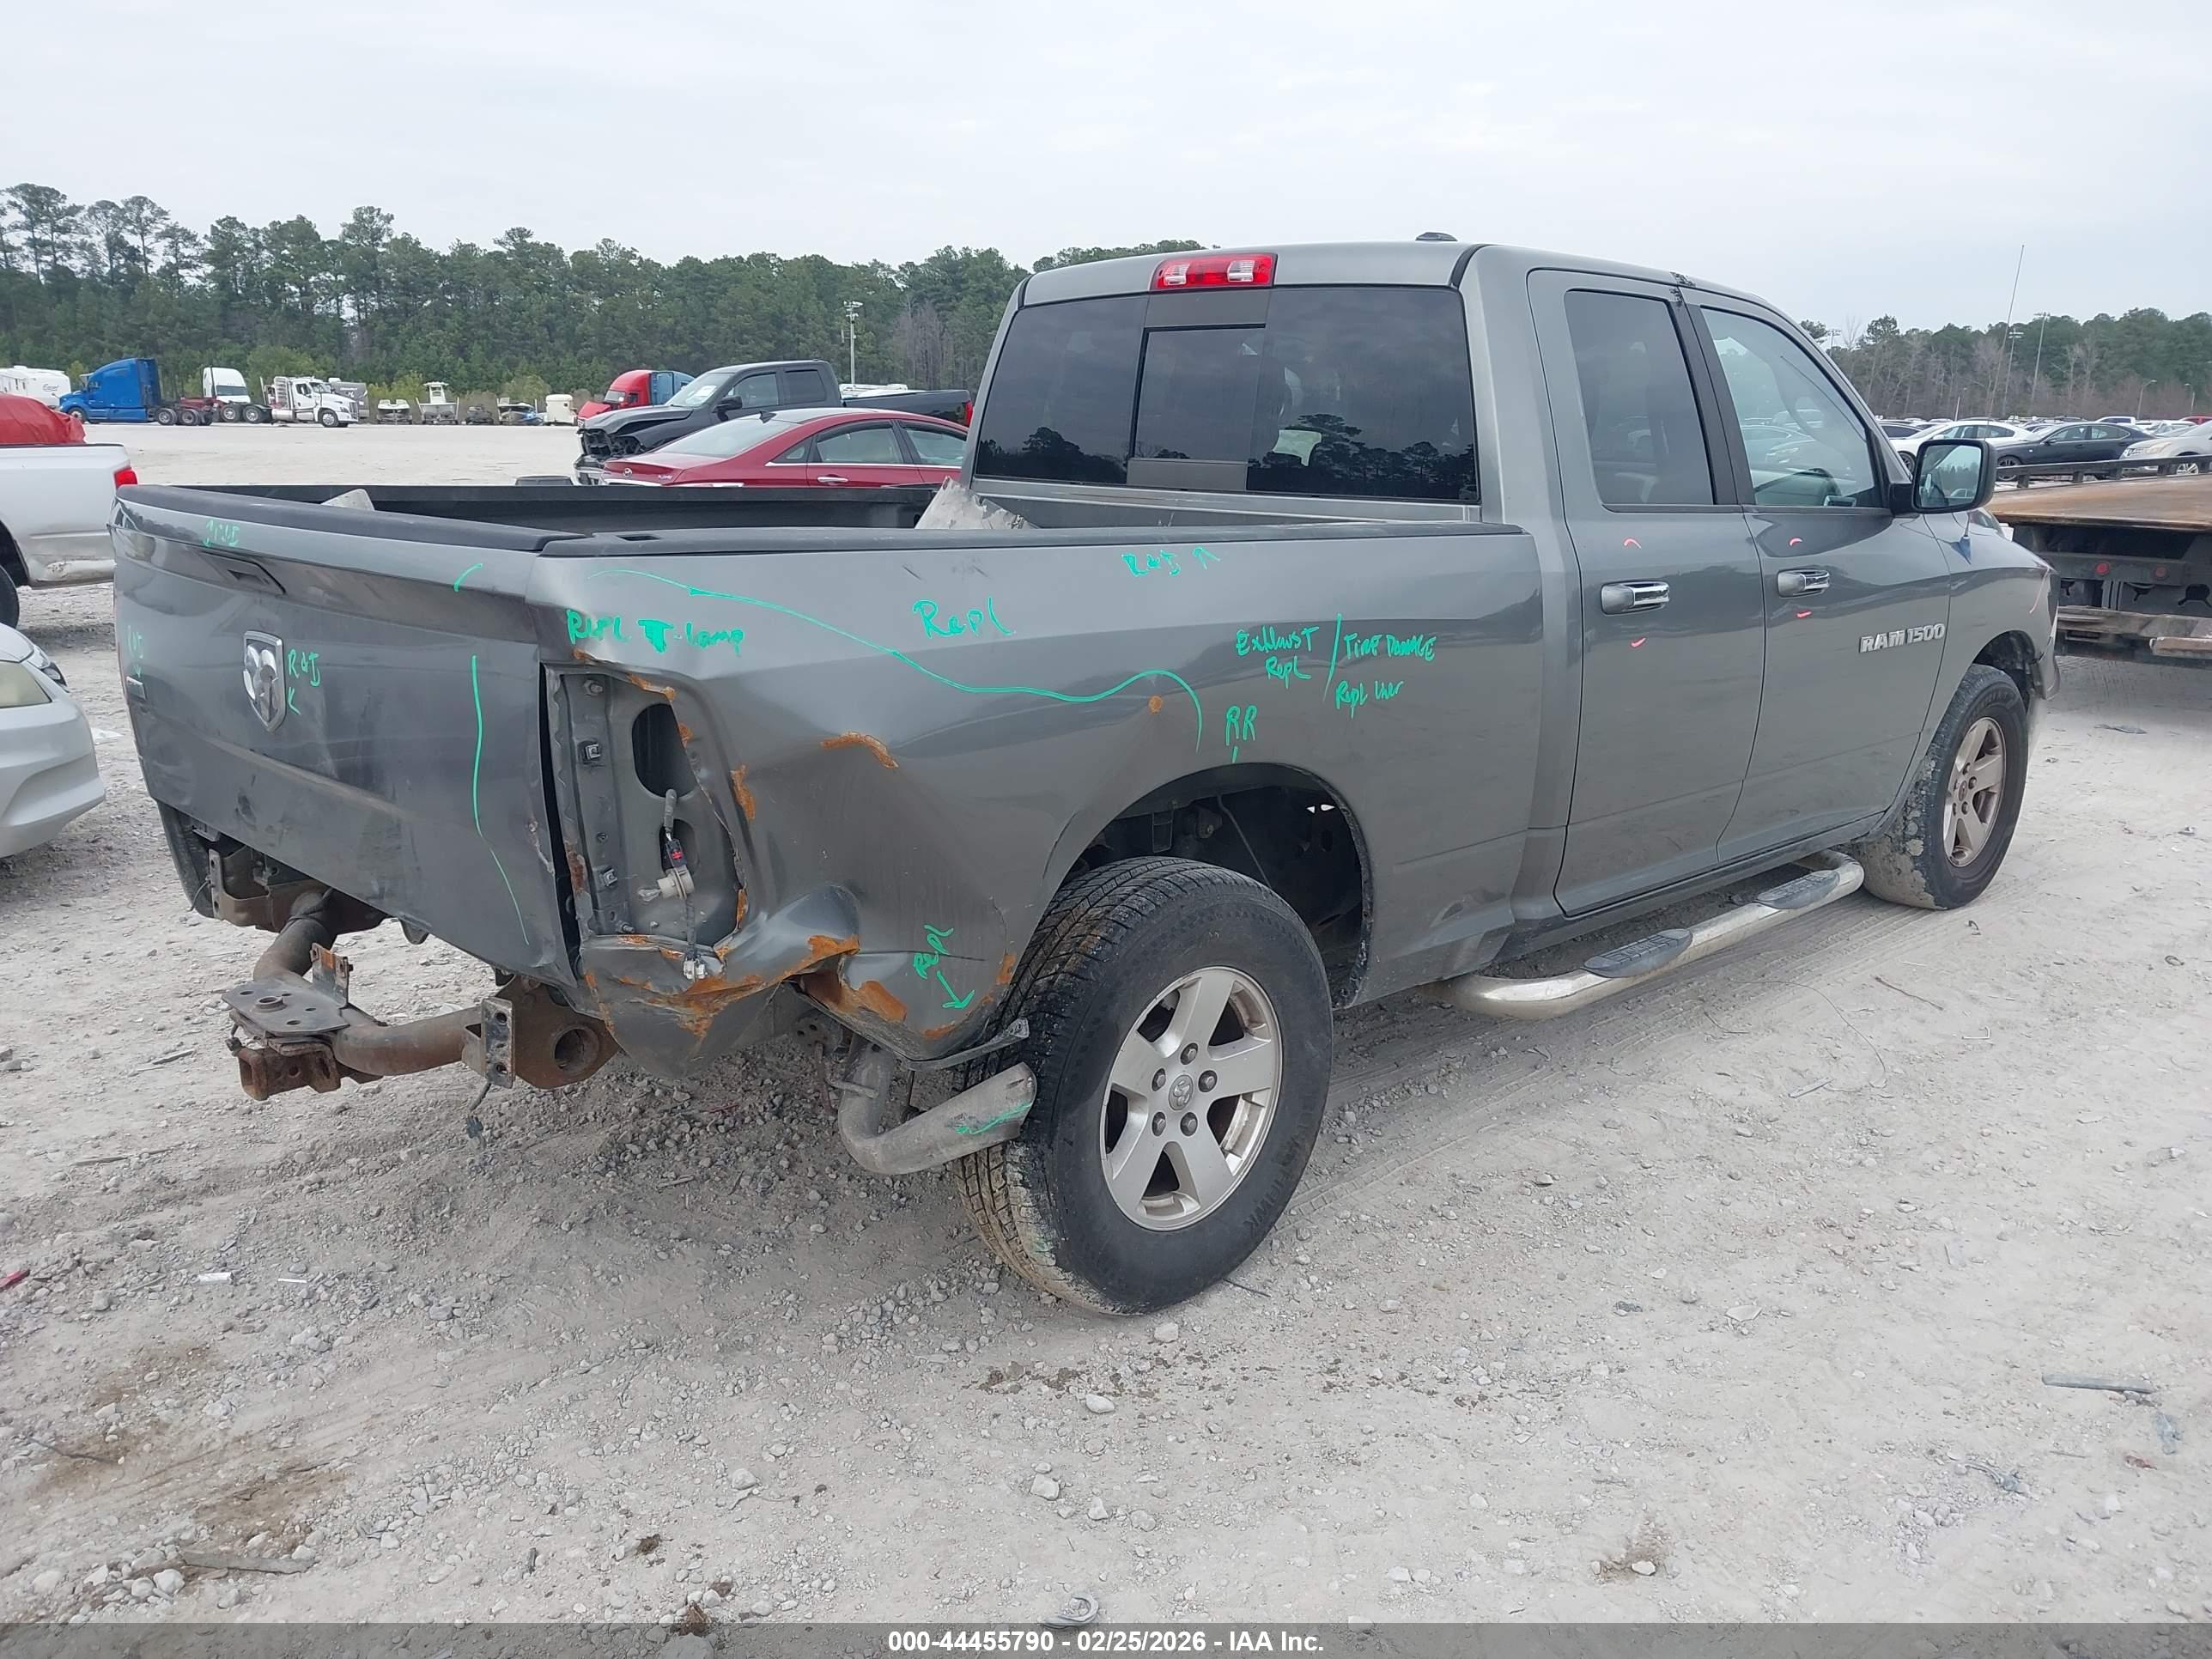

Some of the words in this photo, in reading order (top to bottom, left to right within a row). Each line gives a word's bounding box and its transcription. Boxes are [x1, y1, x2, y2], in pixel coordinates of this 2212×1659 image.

[912, 596, 1014, 639] Repl
[1859, 629, 1905, 653] RAM
[1906, 623, 1946, 644] 1500
[1225, 705, 1258, 746] RR
